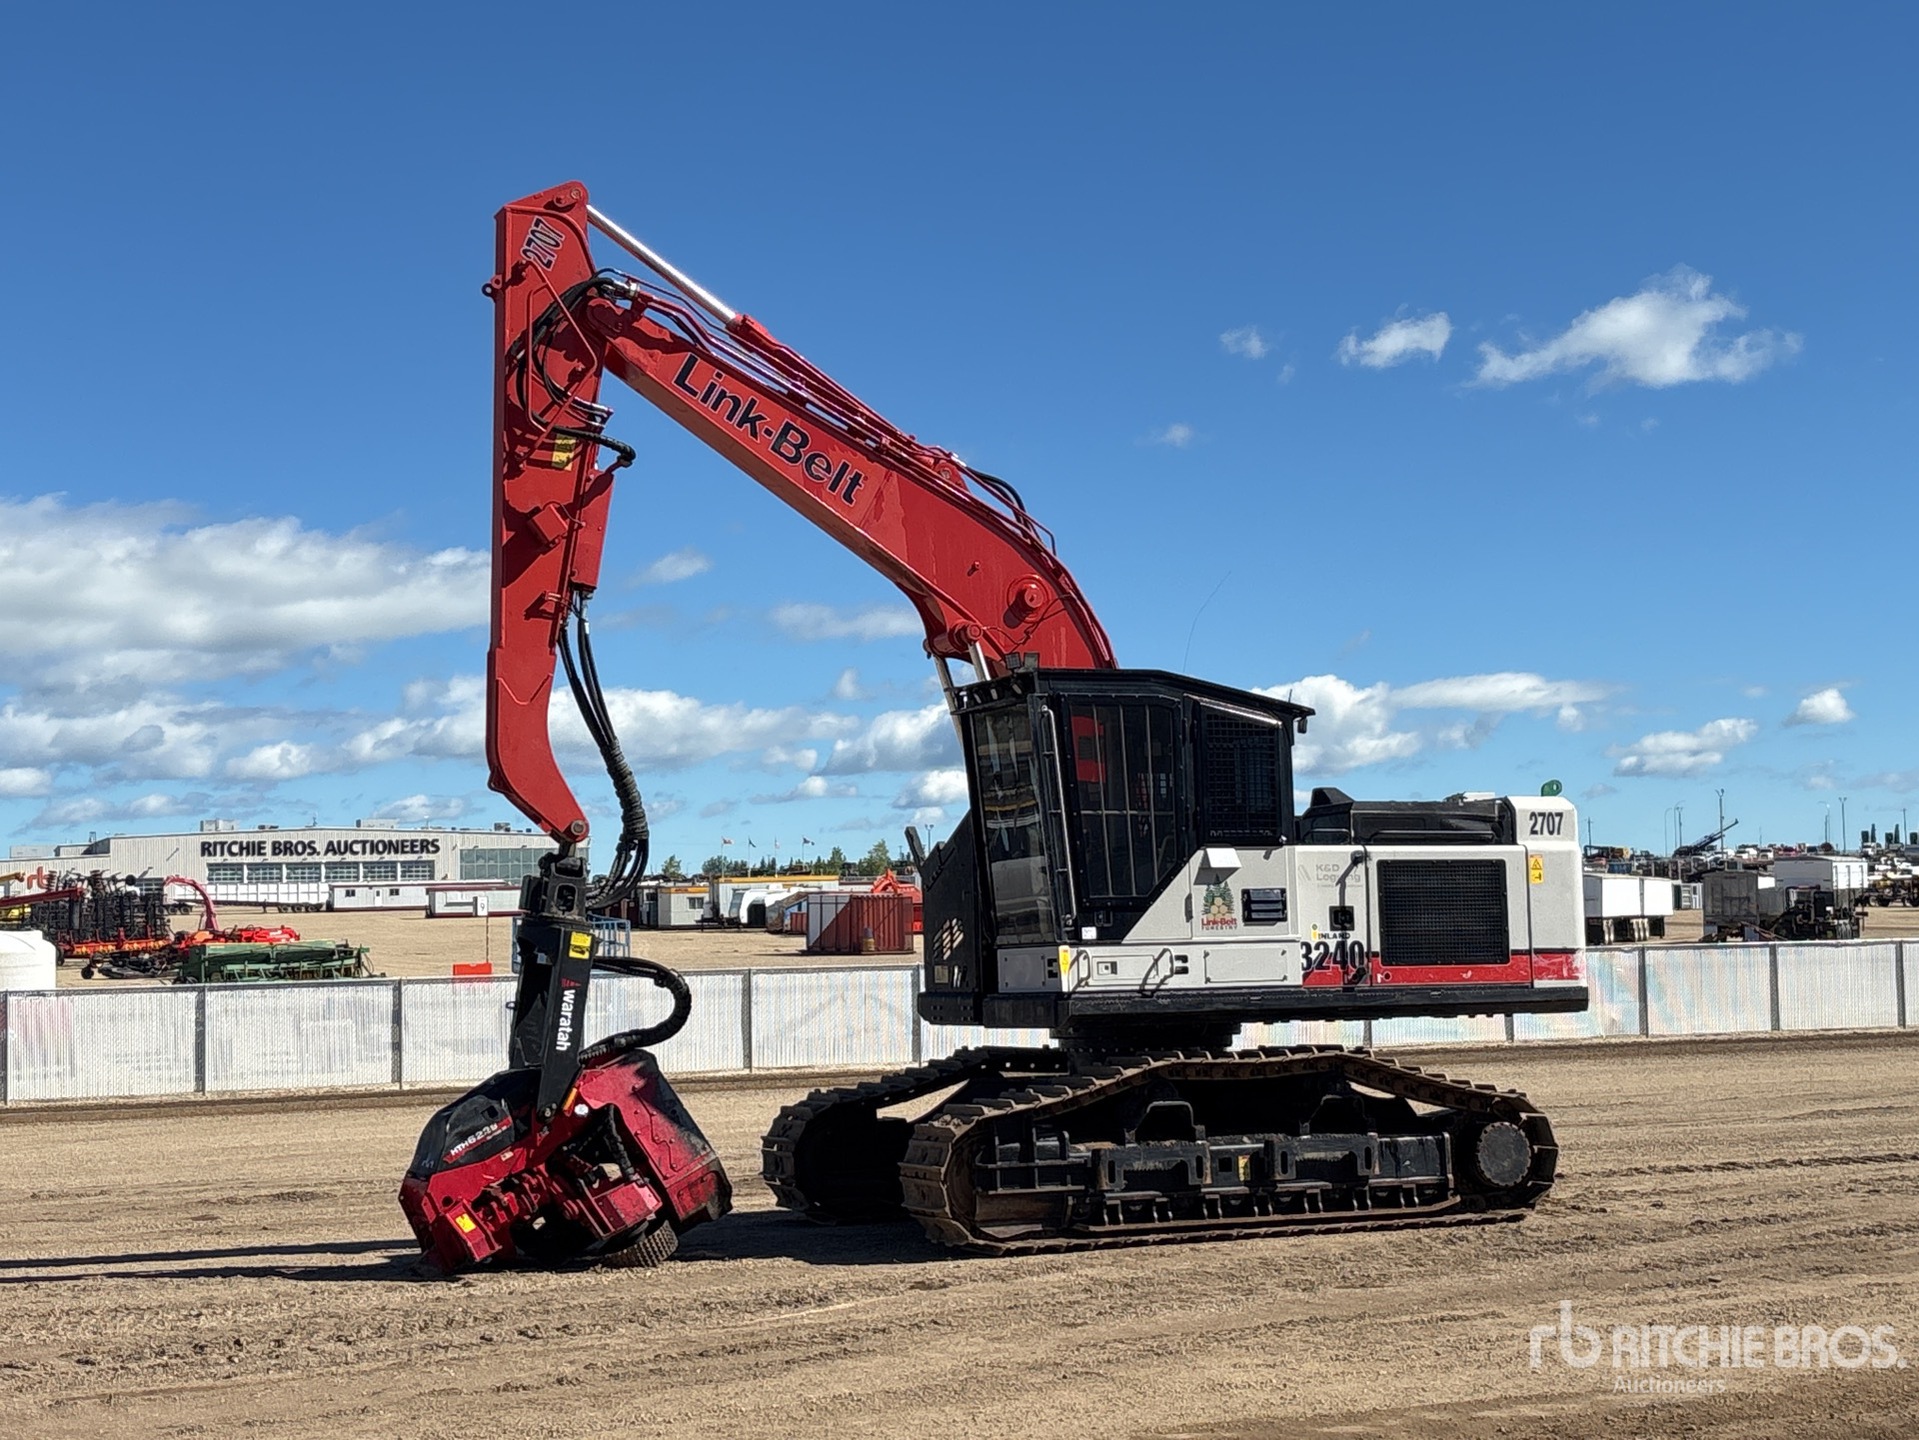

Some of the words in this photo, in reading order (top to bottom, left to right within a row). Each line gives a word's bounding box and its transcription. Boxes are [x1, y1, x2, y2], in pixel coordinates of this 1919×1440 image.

[521, 216, 565, 271] 2707
[673, 353, 865, 506] Link-Belt
[1529, 811, 1563, 835] 2707
[200, 841, 267, 857] RITCHIE
[271, 840, 320, 857] BROS.
[323, 838, 440, 856] AUCTIONEERS
[1316, 873, 1361, 883] Logng
[1300, 940, 1365, 972] 3240
[556, 989, 576, 1051] waratah
